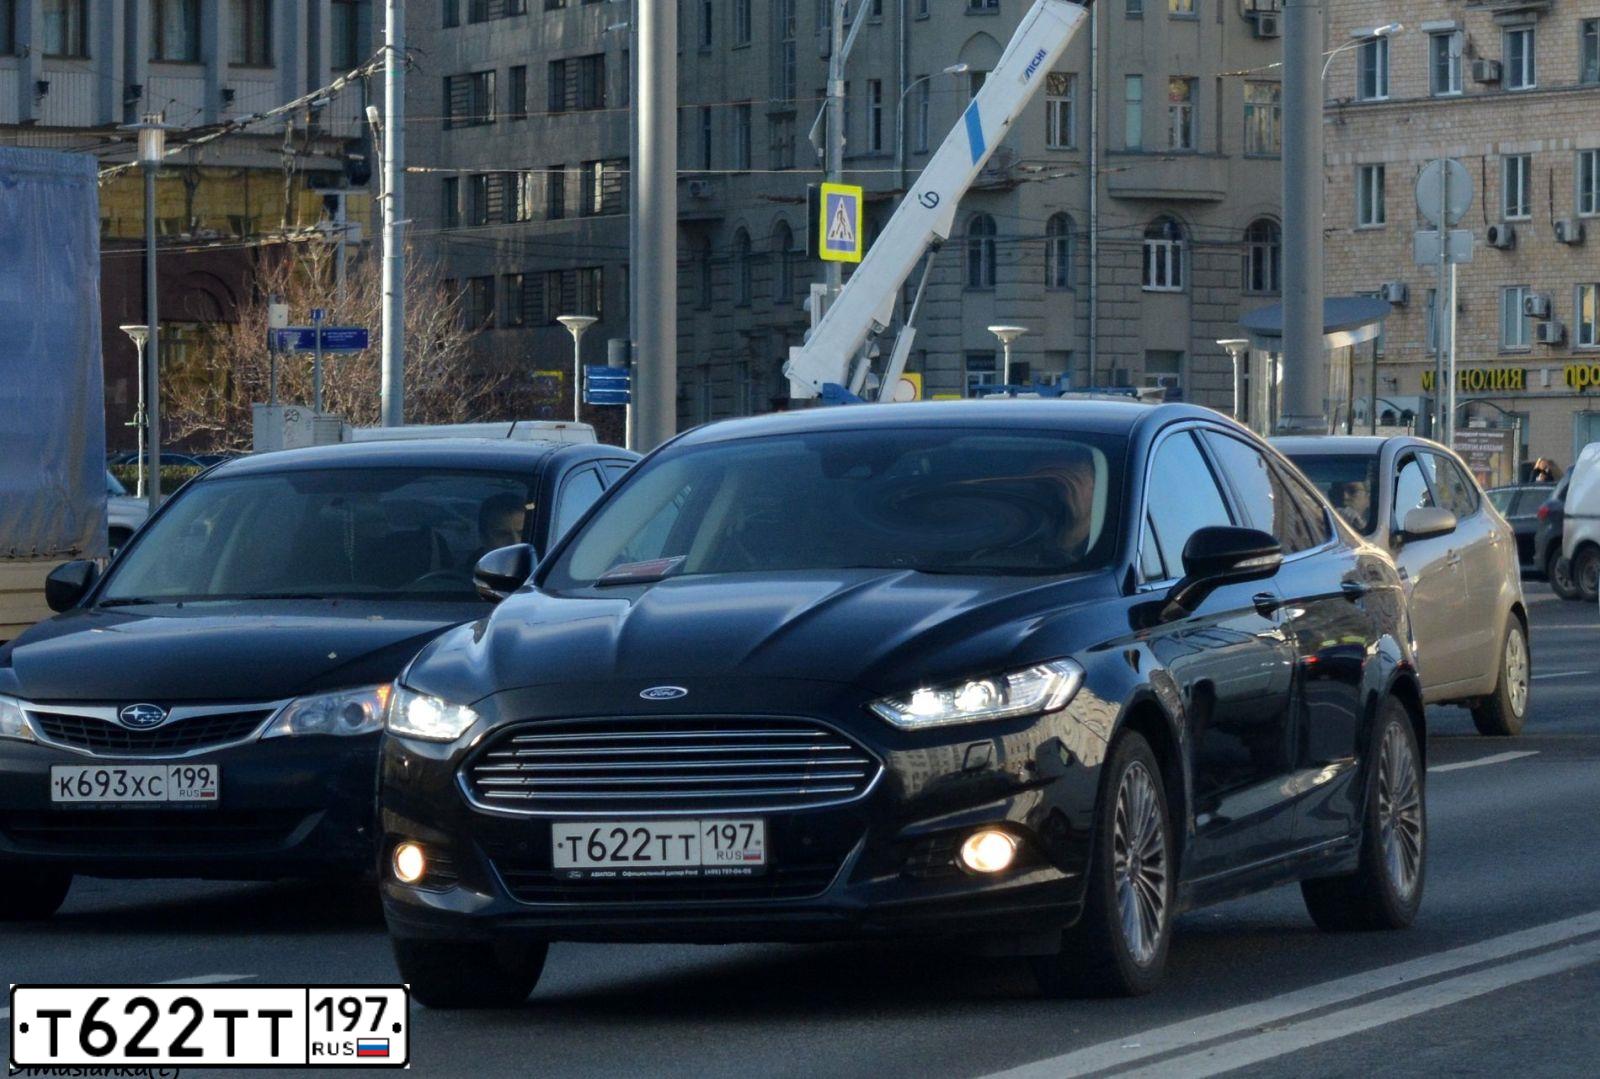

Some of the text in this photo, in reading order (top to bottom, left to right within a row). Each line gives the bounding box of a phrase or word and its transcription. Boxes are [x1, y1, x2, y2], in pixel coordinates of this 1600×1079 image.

[1421, 367, 1523, 390] МНОЛИЯ
[60, 767, 210, 797] К693ХС 199
[179, 789, 200, 798] RUS
[565, 823, 755, 862] Т622ТТ 197
[716, 850, 742, 861] RUS
